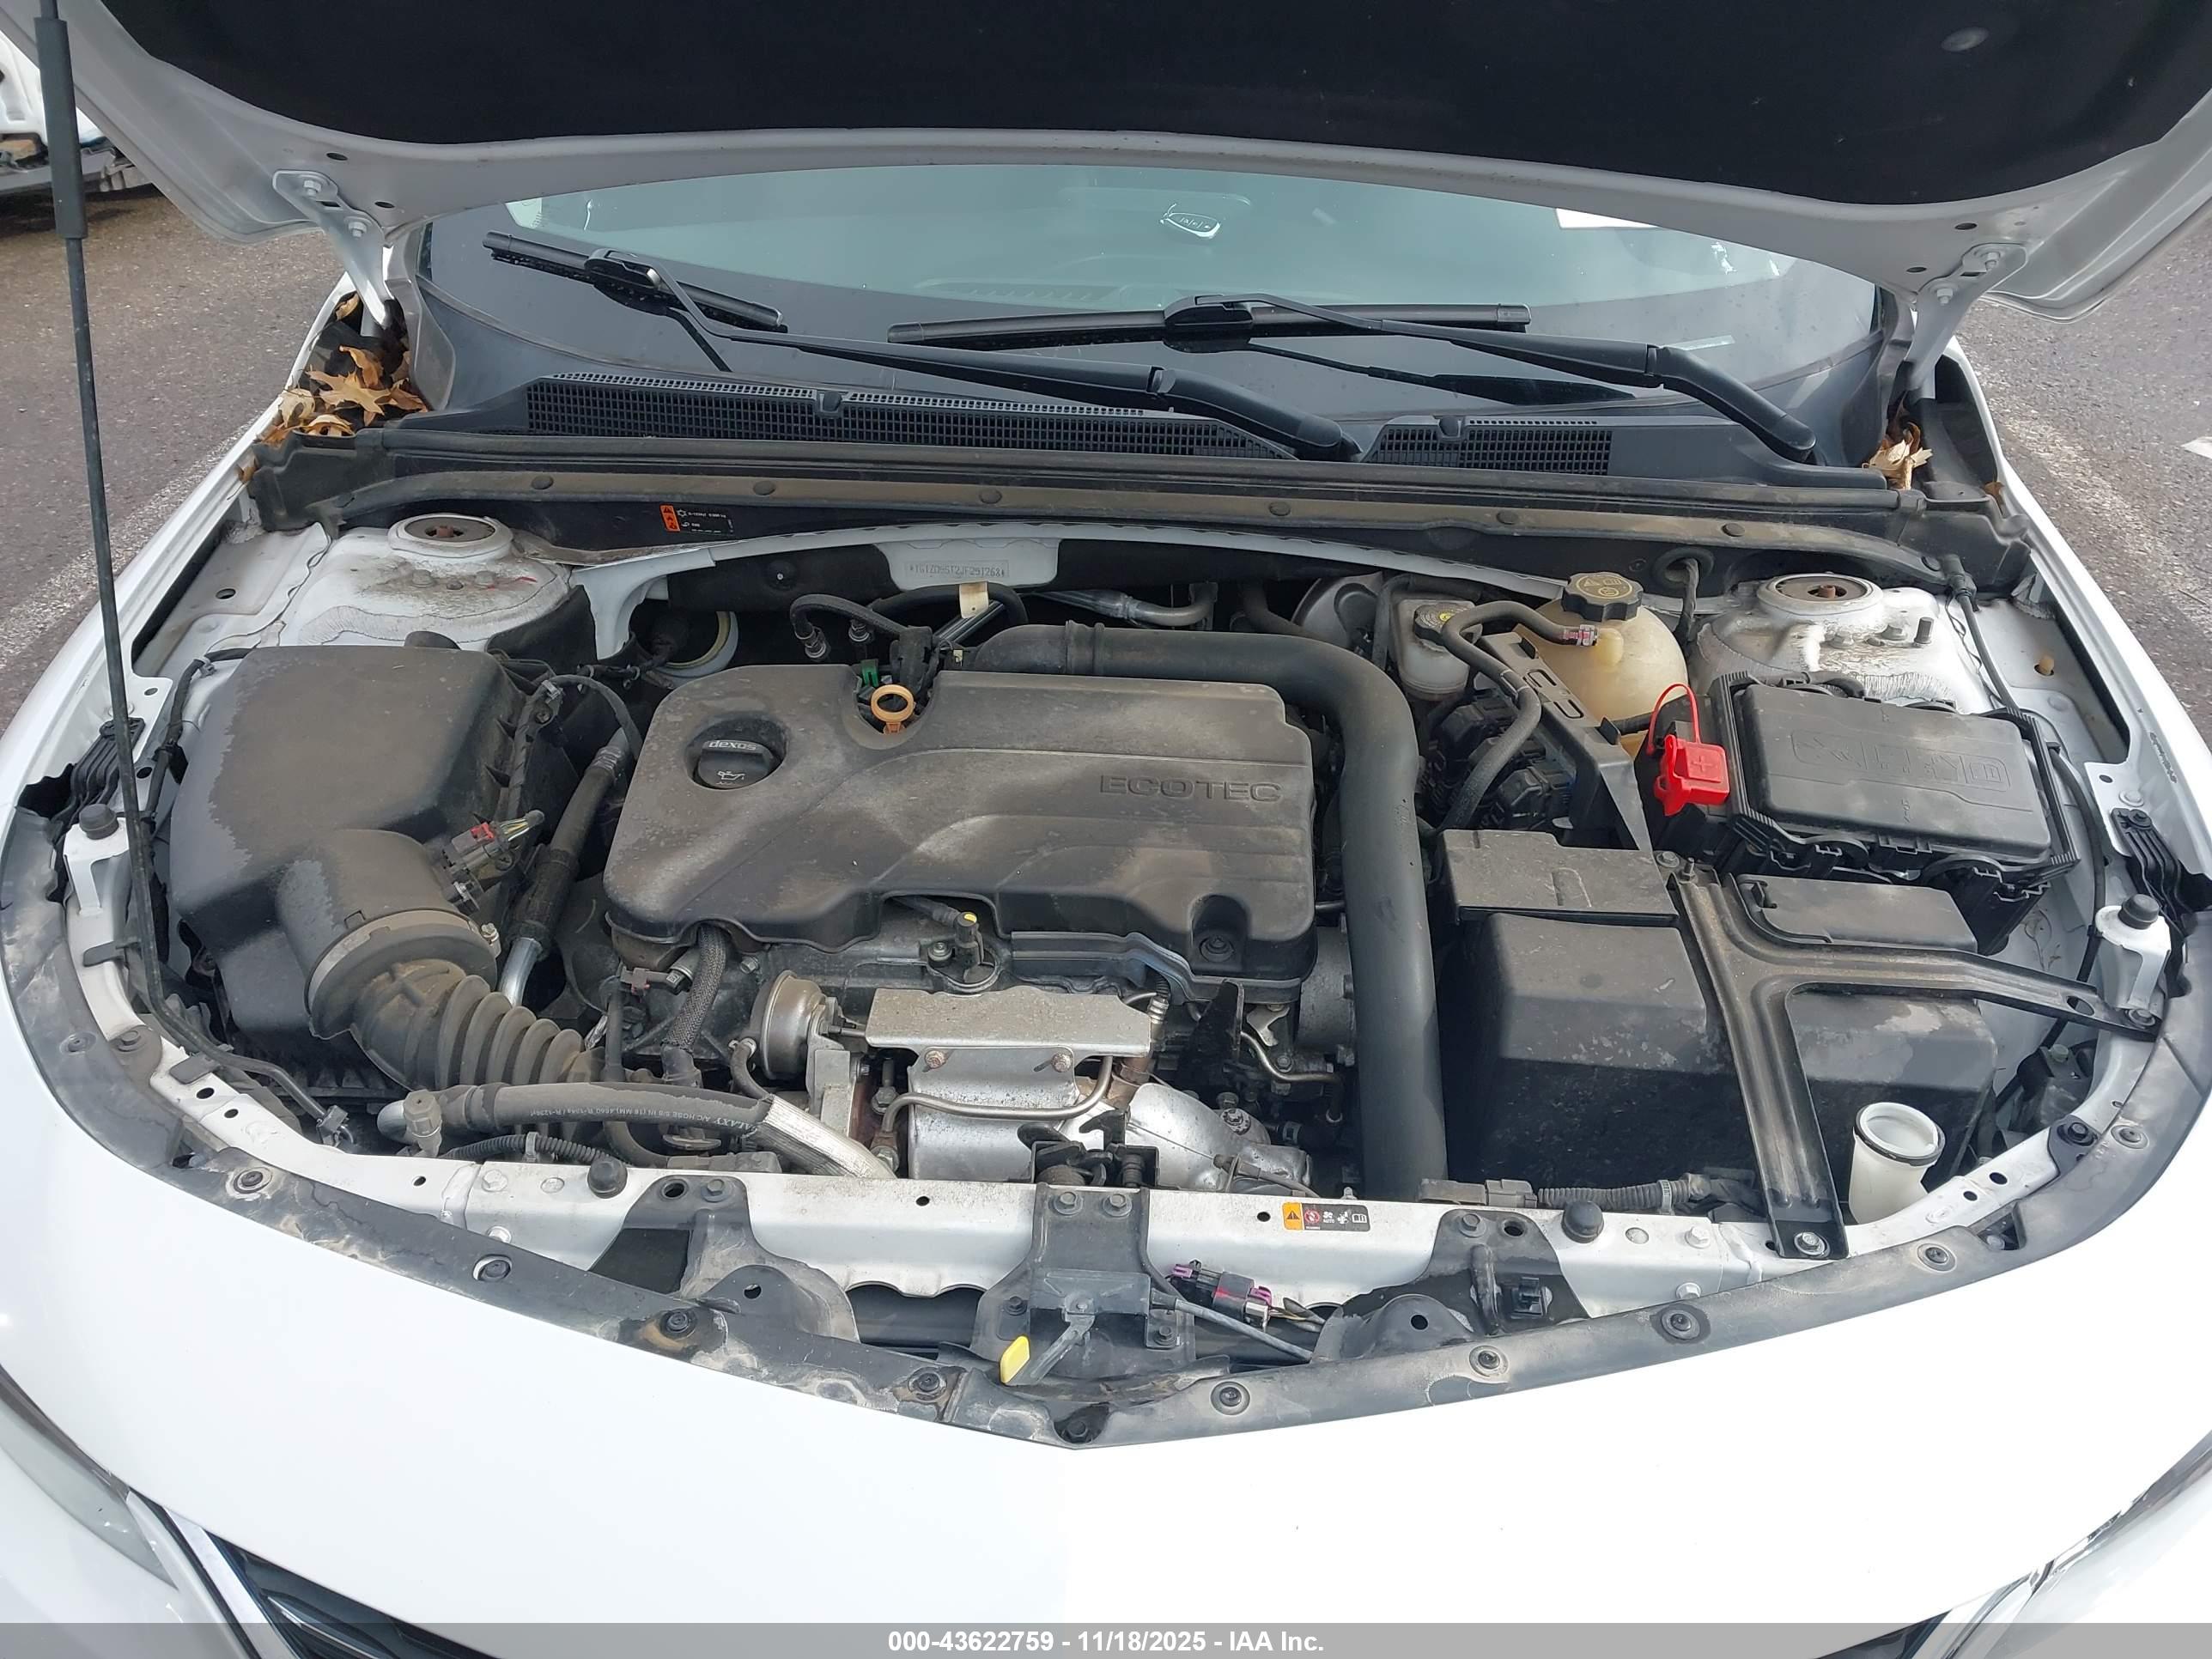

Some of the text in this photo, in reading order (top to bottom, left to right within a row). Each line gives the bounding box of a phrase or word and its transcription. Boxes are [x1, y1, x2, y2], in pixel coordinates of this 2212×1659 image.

[708, 740, 757, 750] dexos
[1098, 775, 1283, 803] ECOTEC
[673, 1112, 694, 1121] HOSE
